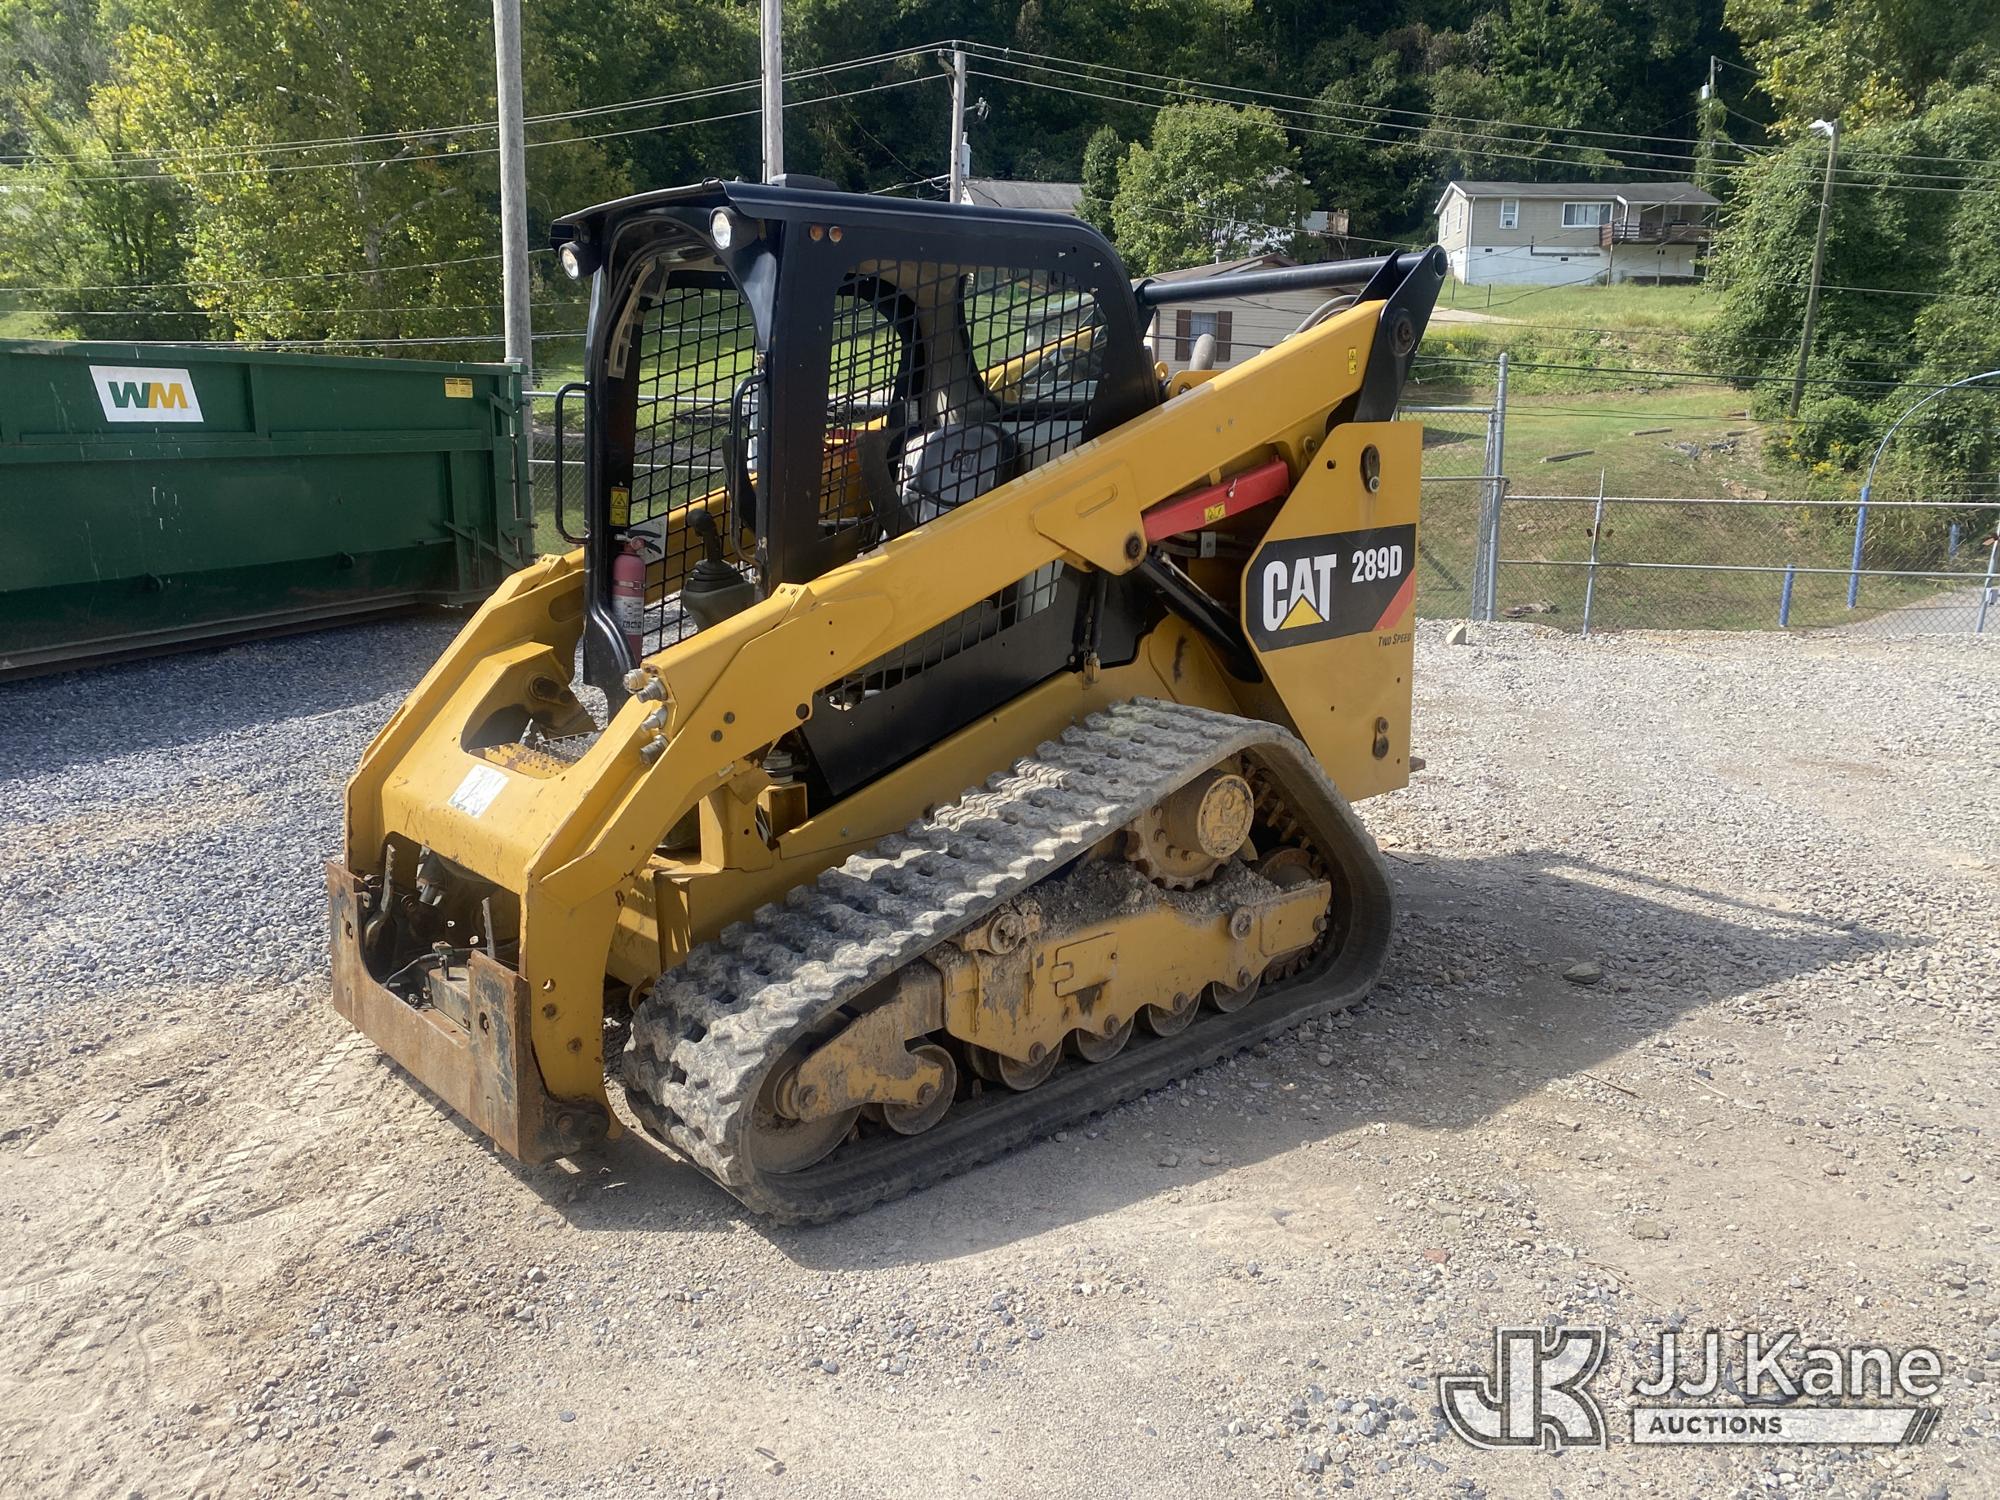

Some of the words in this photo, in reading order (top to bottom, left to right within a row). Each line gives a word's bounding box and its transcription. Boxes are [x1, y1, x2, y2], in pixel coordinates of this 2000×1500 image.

[108, 381, 189, 409] WM
[1263, 553, 1337, 632] CAT
[1351, 545, 1403, 584] 289D
